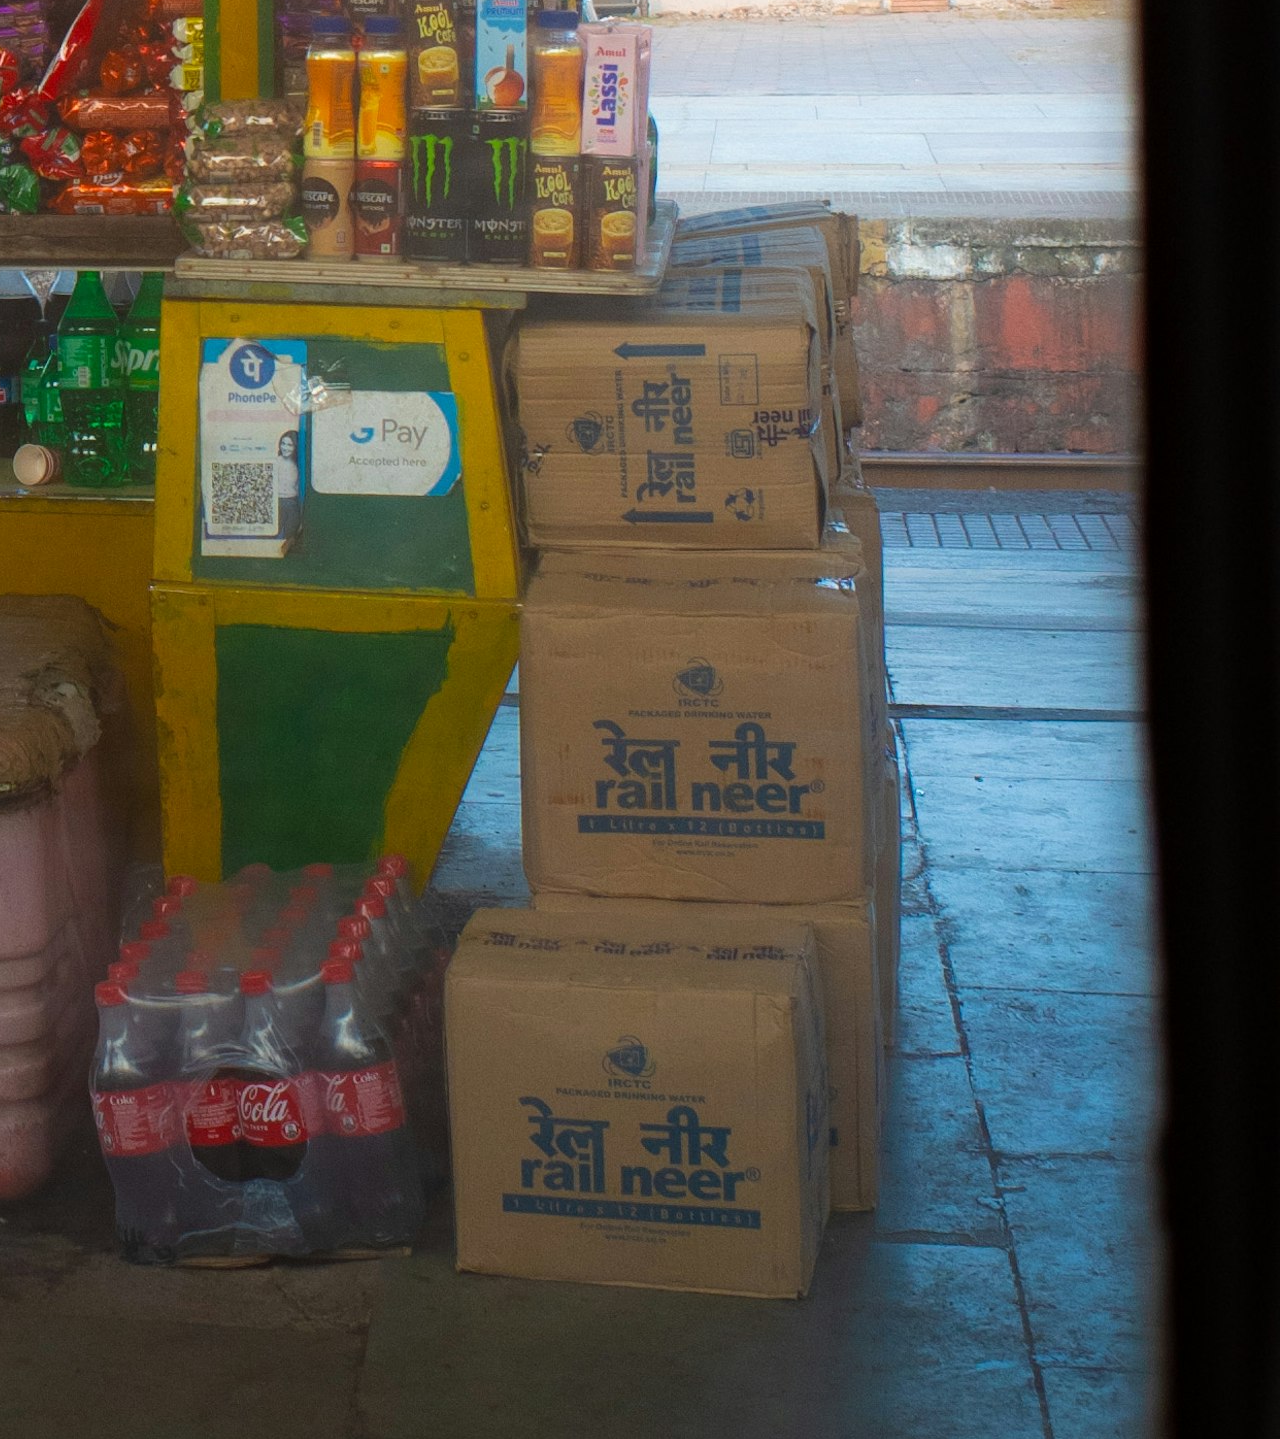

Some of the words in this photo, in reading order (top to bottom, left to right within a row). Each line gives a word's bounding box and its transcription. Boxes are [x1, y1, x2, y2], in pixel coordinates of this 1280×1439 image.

[414, 2, 445, 15] Amul
[485, 6, 525, 17] PREMIUM
[417, 9, 454, 39] KOOL
[594, 45, 627, 58] Amul
[595, 63, 620, 128] Lassi
[534, 163, 563, 175] Amul
[602, 164, 632, 176] Amul
[534, 171, 572, 199] KOOL
[240, 349, 263, 382] पे
[227, 391, 277, 405] PhonePe
[381, 418, 429, 450] Pay
[348, 455, 400, 470] Accepted
[401, 456, 427, 467] here
[677, 697, 721, 709] IRCTC
[627, 709, 682, 720] PACKAGED
[683, 710, 735, 720] DRINKING
[736, 710, 773, 721] WATER
[592, 719, 681, 777] रेल
[708, 721, 798, 782] नीर
[594, 770, 678, 812] rail
[352, 1069, 382, 1085] Coke
[607, 1078, 652, 1091] IRCTC
[109, 1093, 137, 1106] Coke
[240, 1082, 290, 1122] Cola
[555, 1086, 612, 1099] PACKAGED
[613, 1089, 667, 1102] DRINKING
[669, 1093, 707, 1105] WATER
[518, 1095, 610, 1160] रेल
[639, 1104, 732, 1170] नीर
[520, 1153, 606, 1194] rail
